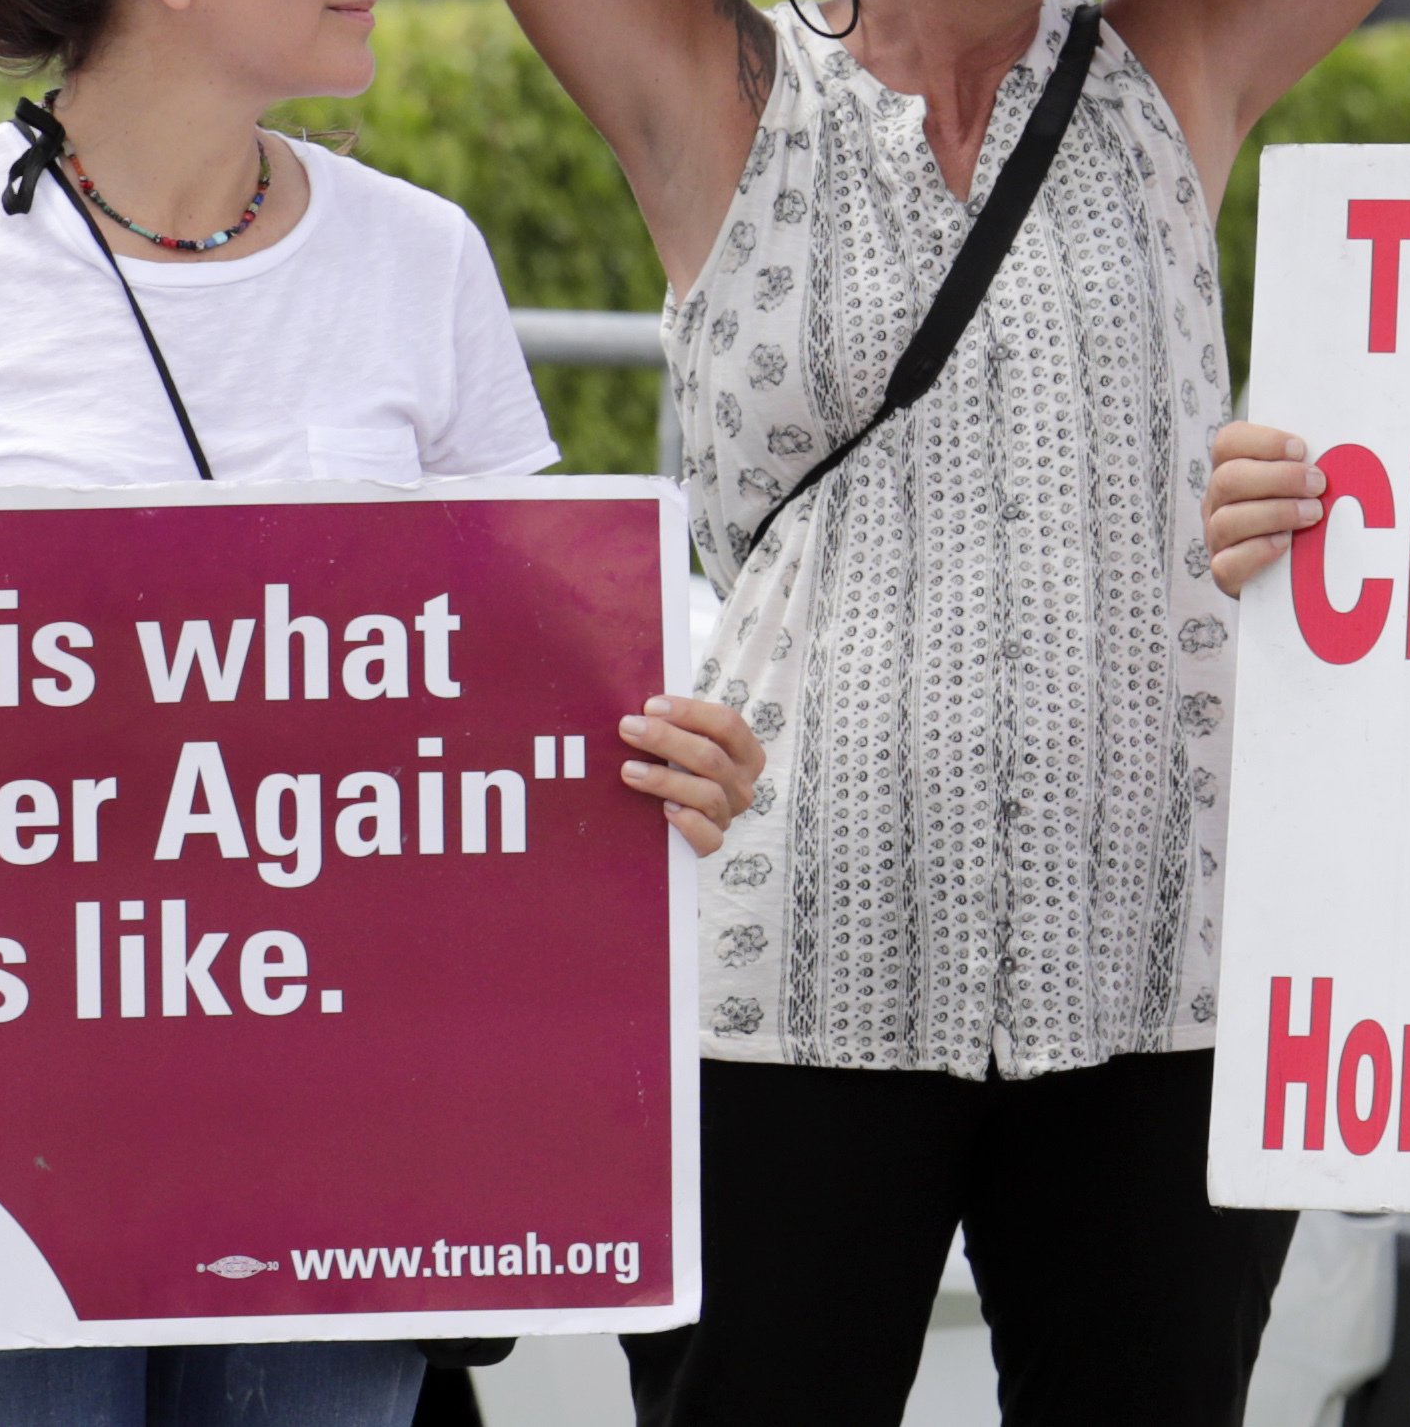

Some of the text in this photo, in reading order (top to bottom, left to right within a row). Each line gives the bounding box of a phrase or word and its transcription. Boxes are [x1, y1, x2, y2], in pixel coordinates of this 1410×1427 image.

[135, 582, 462, 705] what
[152, 734, 586, 889] Again"
[74, 898, 344, 1021] like.
[290, 1231, 641, 1285] www.truah.org
